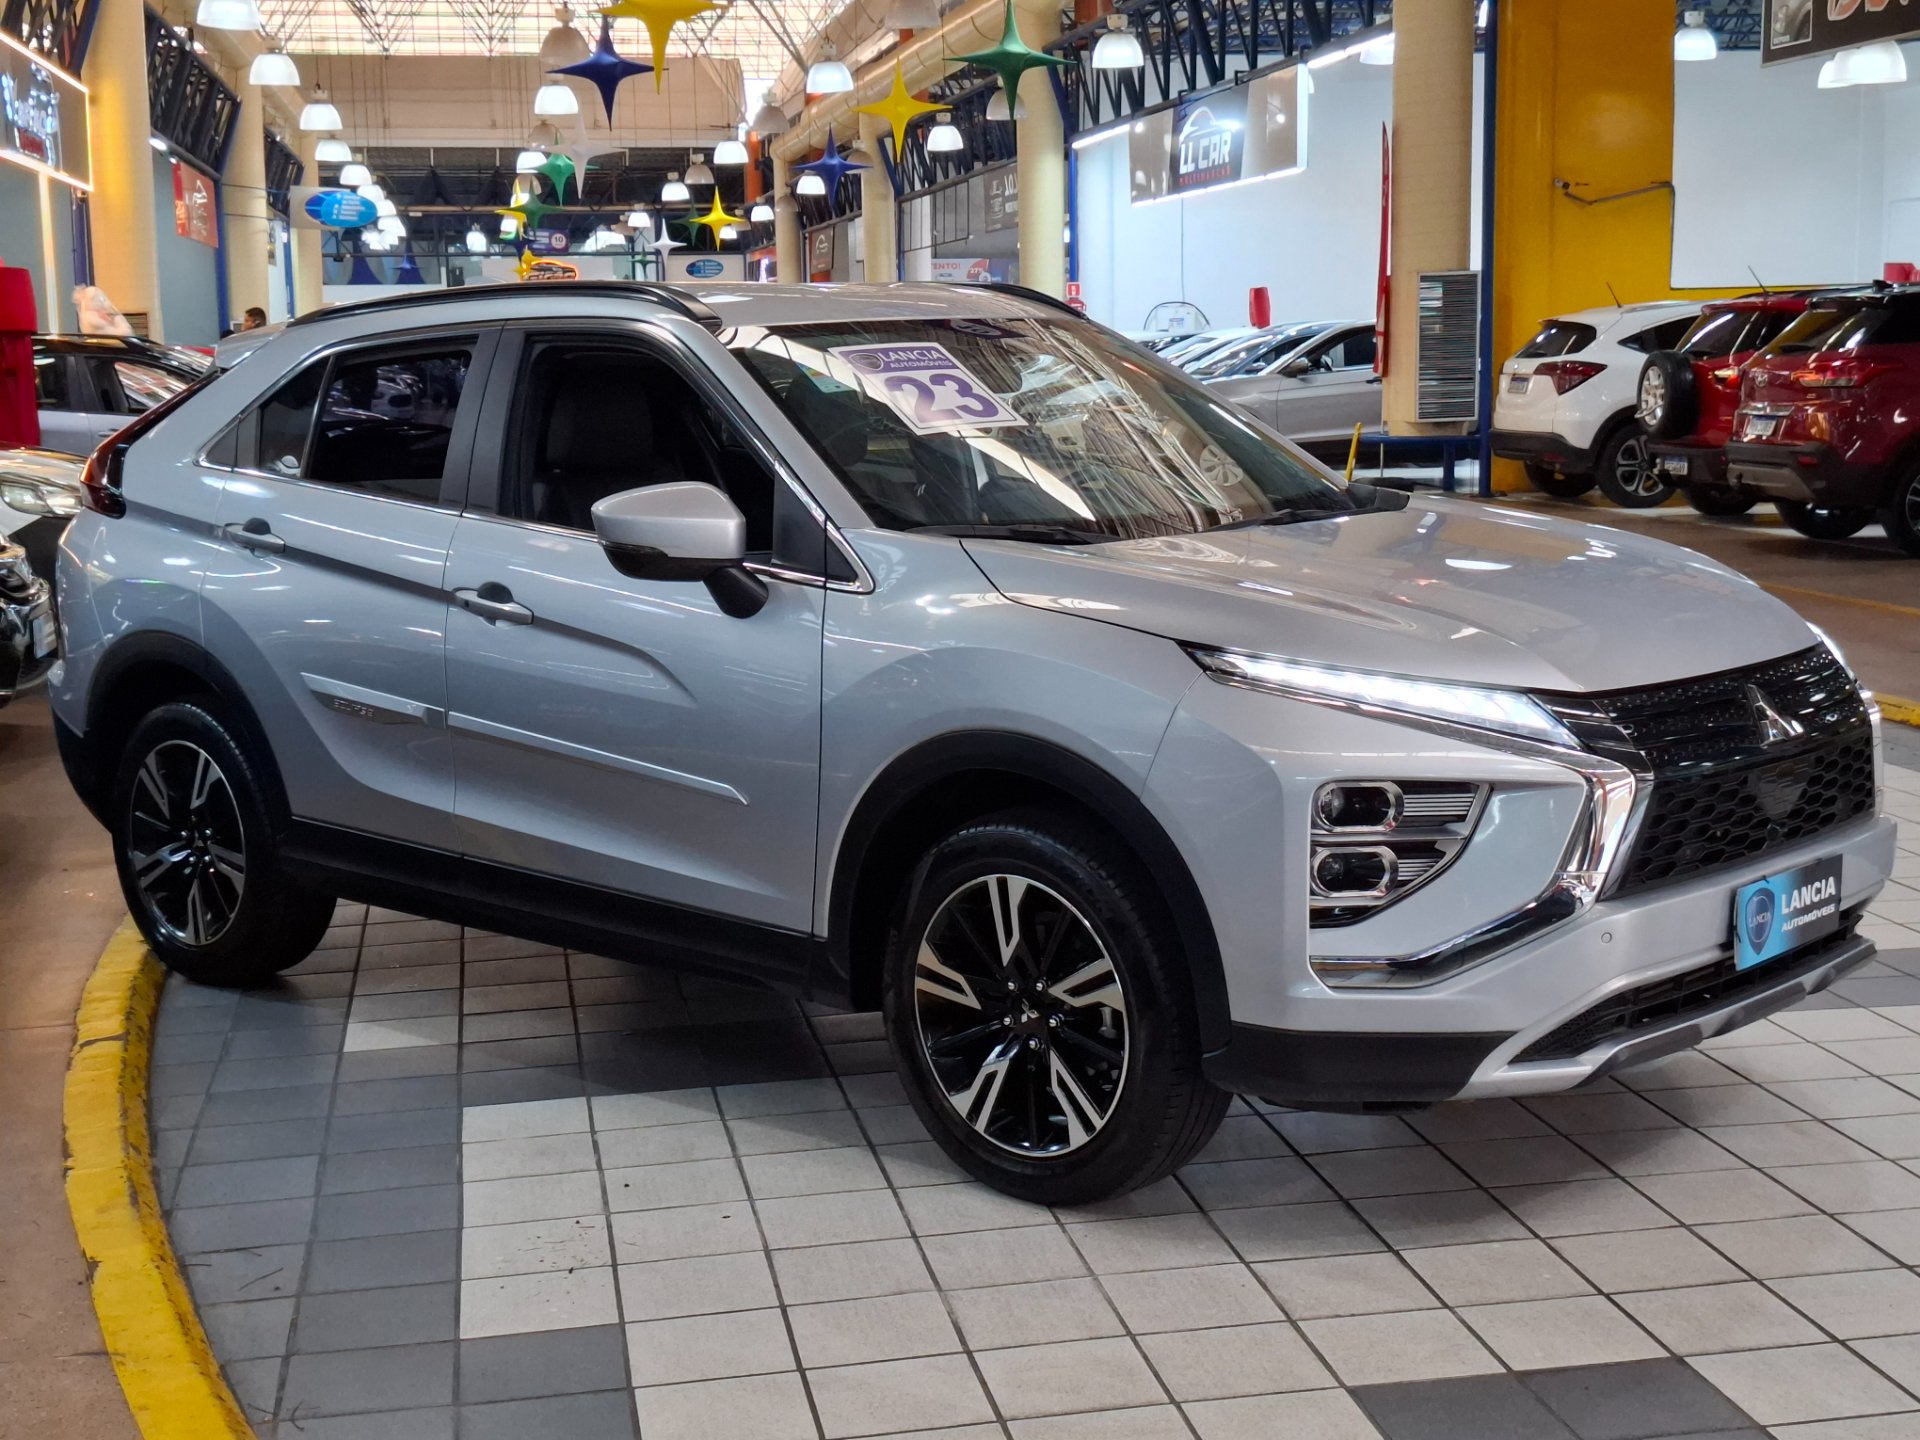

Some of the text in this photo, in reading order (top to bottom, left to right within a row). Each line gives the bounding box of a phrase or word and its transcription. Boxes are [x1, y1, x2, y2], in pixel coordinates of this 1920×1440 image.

[1179, 130, 1232, 175] LL CAR
[931, 262, 961, 271] ENTO!
[878, 350, 945, 361] LANCIA
[890, 360, 953, 368] AUTOMÓVEIS
[884, 373, 999, 423] 23
[1781, 876, 1836, 915] LANCIA
[1781, 903, 1836, 932] AUTOMÓVEIS
